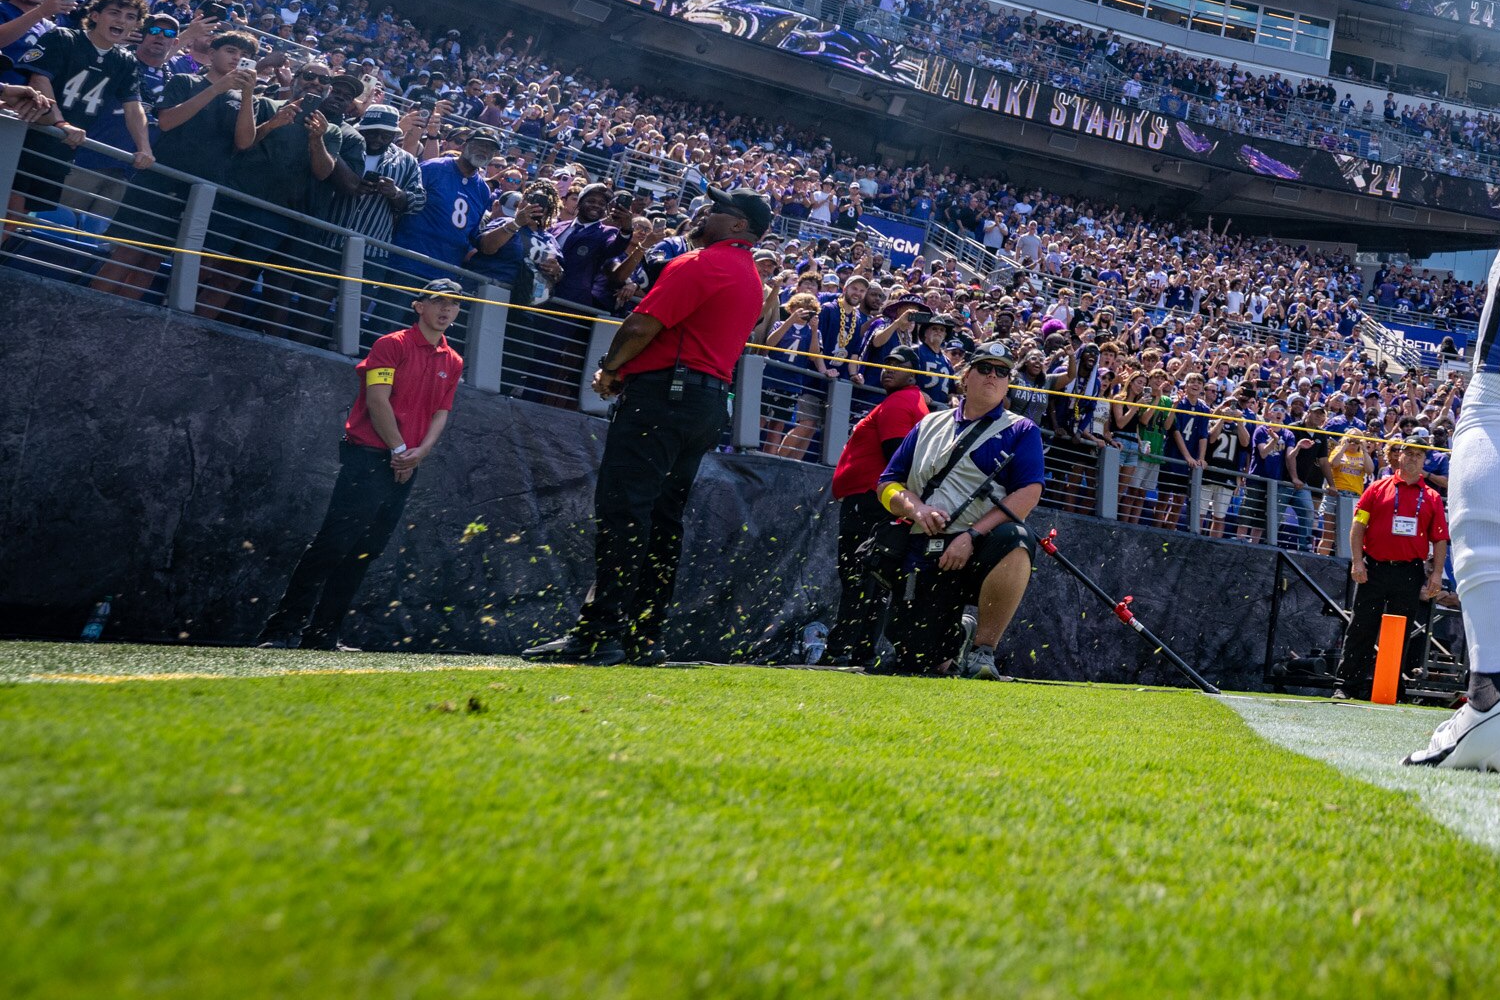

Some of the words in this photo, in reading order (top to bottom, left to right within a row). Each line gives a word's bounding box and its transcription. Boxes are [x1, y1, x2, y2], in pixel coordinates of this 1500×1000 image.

[1469, 1, 1495, 29] 24
[62, 69, 110, 116] 44
[914, 55, 1040, 120] MALAKI
[1050, 90, 1169, 150] STARKS
[453, 101, 473, 118] 37
[1368, 162, 1402, 198] 24
[451, 197, 469, 229] 8
[784, 338, 801, 362] 4
[1014, 389, 1048, 404] RAVENS
[1182, 417, 1194, 441] 4
[1212, 433, 1237, 461] 21
